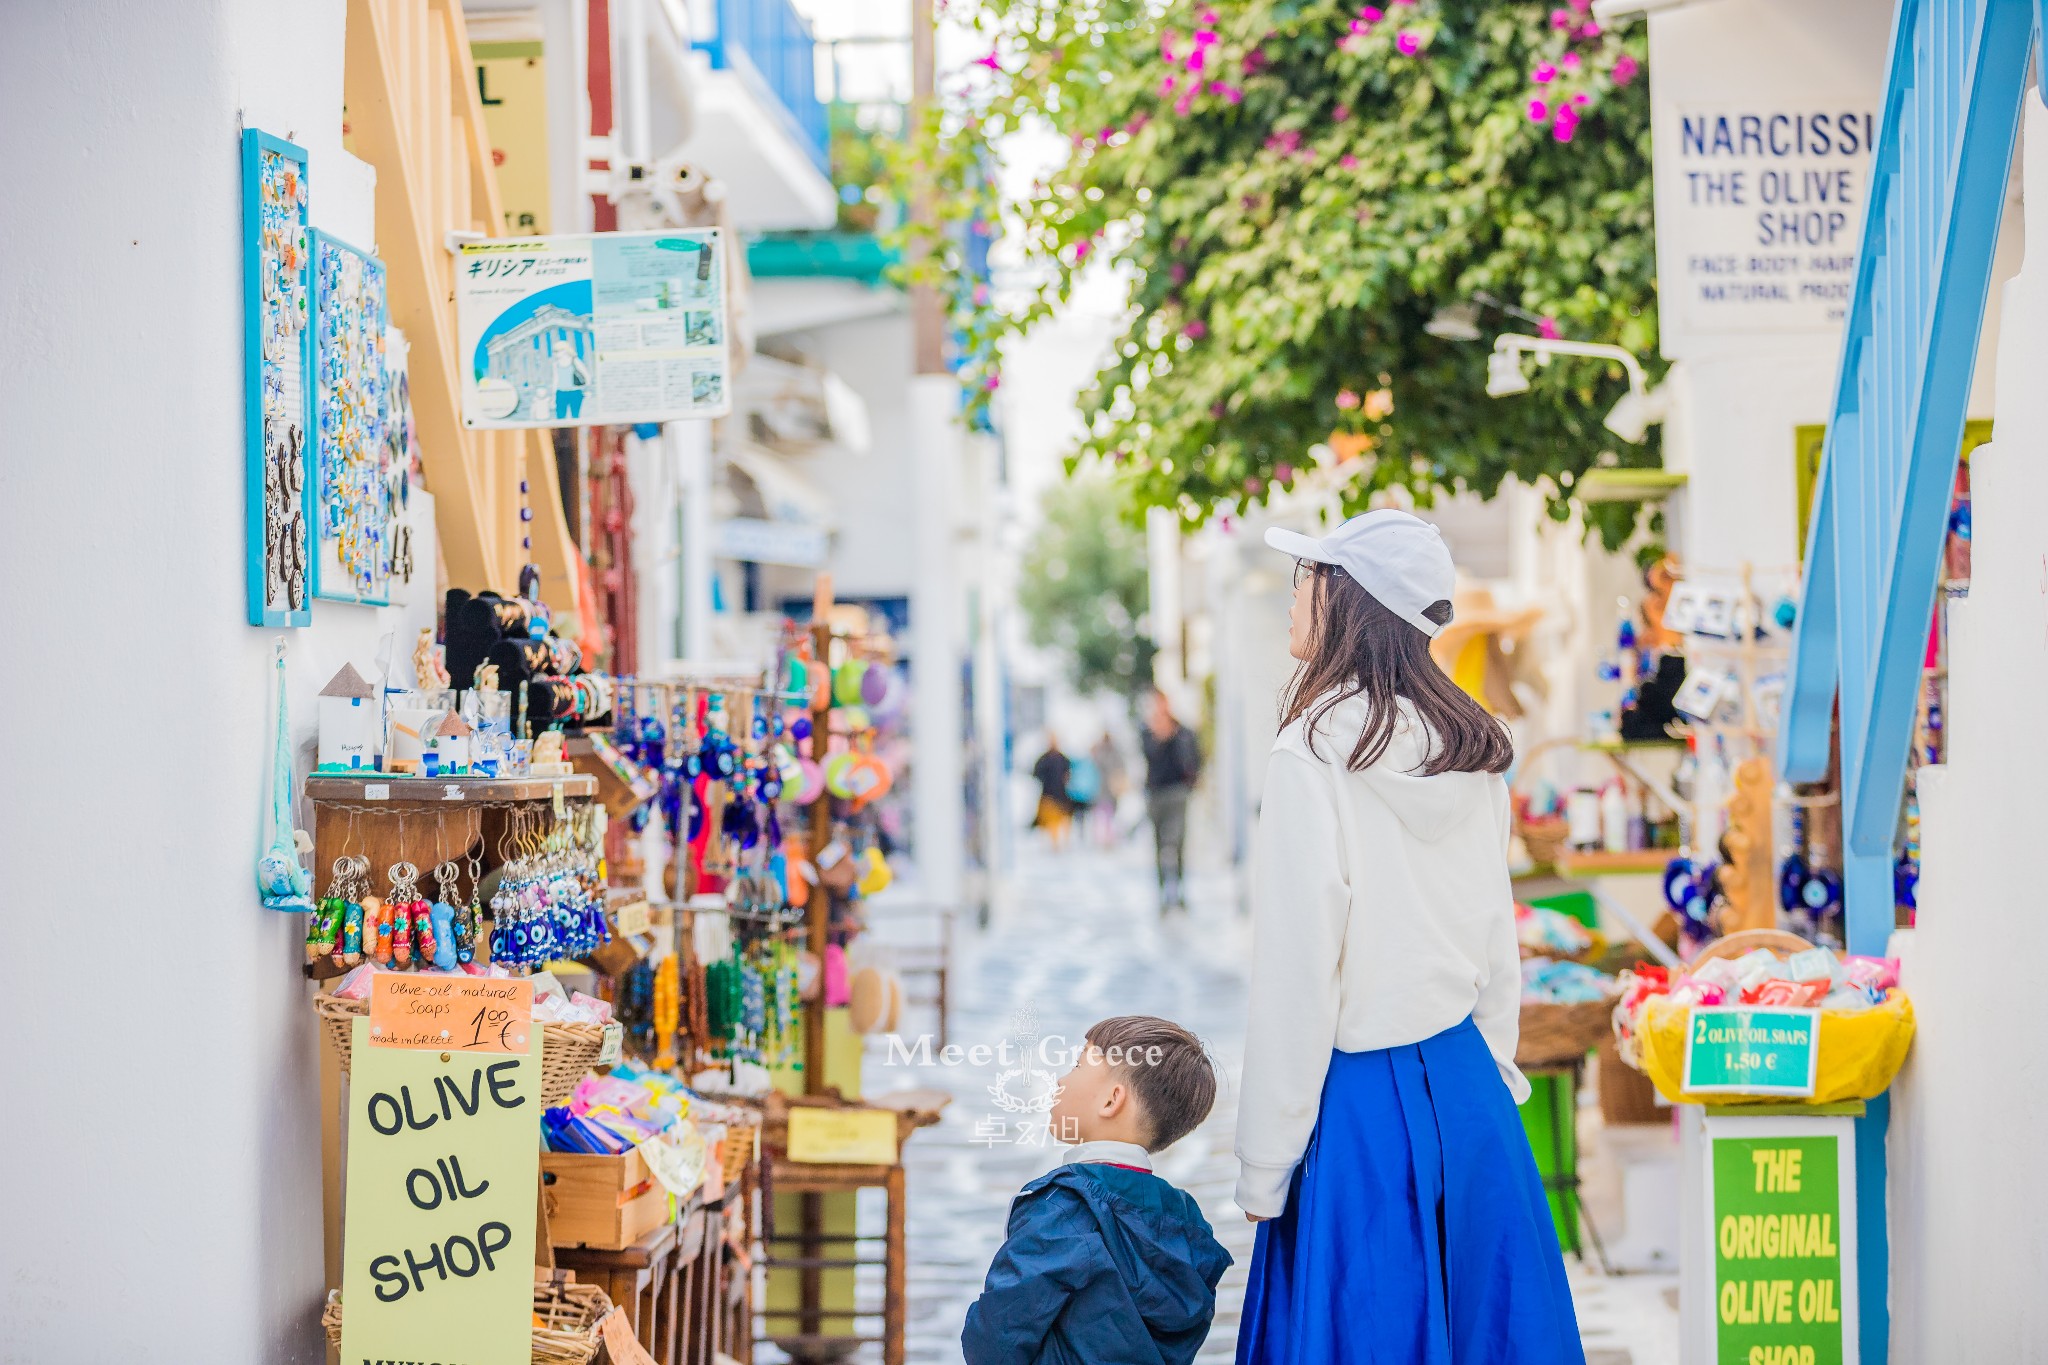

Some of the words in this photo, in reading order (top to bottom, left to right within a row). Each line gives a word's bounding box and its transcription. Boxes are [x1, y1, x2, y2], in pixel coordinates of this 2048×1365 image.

[1688, 171, 1745, 204] THE
[1760, 171, 1854, 204] OLIVE
[1758, 213, 1846, 245] SHOP
[467, 257, 536, 279] ギリシア
[390, 982, 453, 997] Olive-oil
[461, 984, 518, 1000] natural
[406, 1000, 451, 1018] Soaps
[369, 1032, 398, 1044] made
[401, 1036, 412, 1045] in
[413, 1034, 454, 1045] GREECE
[1695, 1018, 1707, 1045] 2
[1708, 1028, 1748, 1044] OLIVE
[1749, 1028, 1771, 1044] OIL
[1771, 1028, 1808, 1045] SOAPS
[1725, 1053, 1761, 1071] 1,50
[1764, 1053, 1778, 1070] €
[367, 1059, 526, 1136] OLIVE
[405, 1154, 490, 1211] OIL
[1752, 1149, 1803, 1193] THE
[1719, 1214, 1837, 1260] ORIGINAL
[369, 1221, 512, 1303] SHOP
[1720, 1280, 1794, 1326] OLIVE
[1798, 1279, 1840, 1323] OIL
